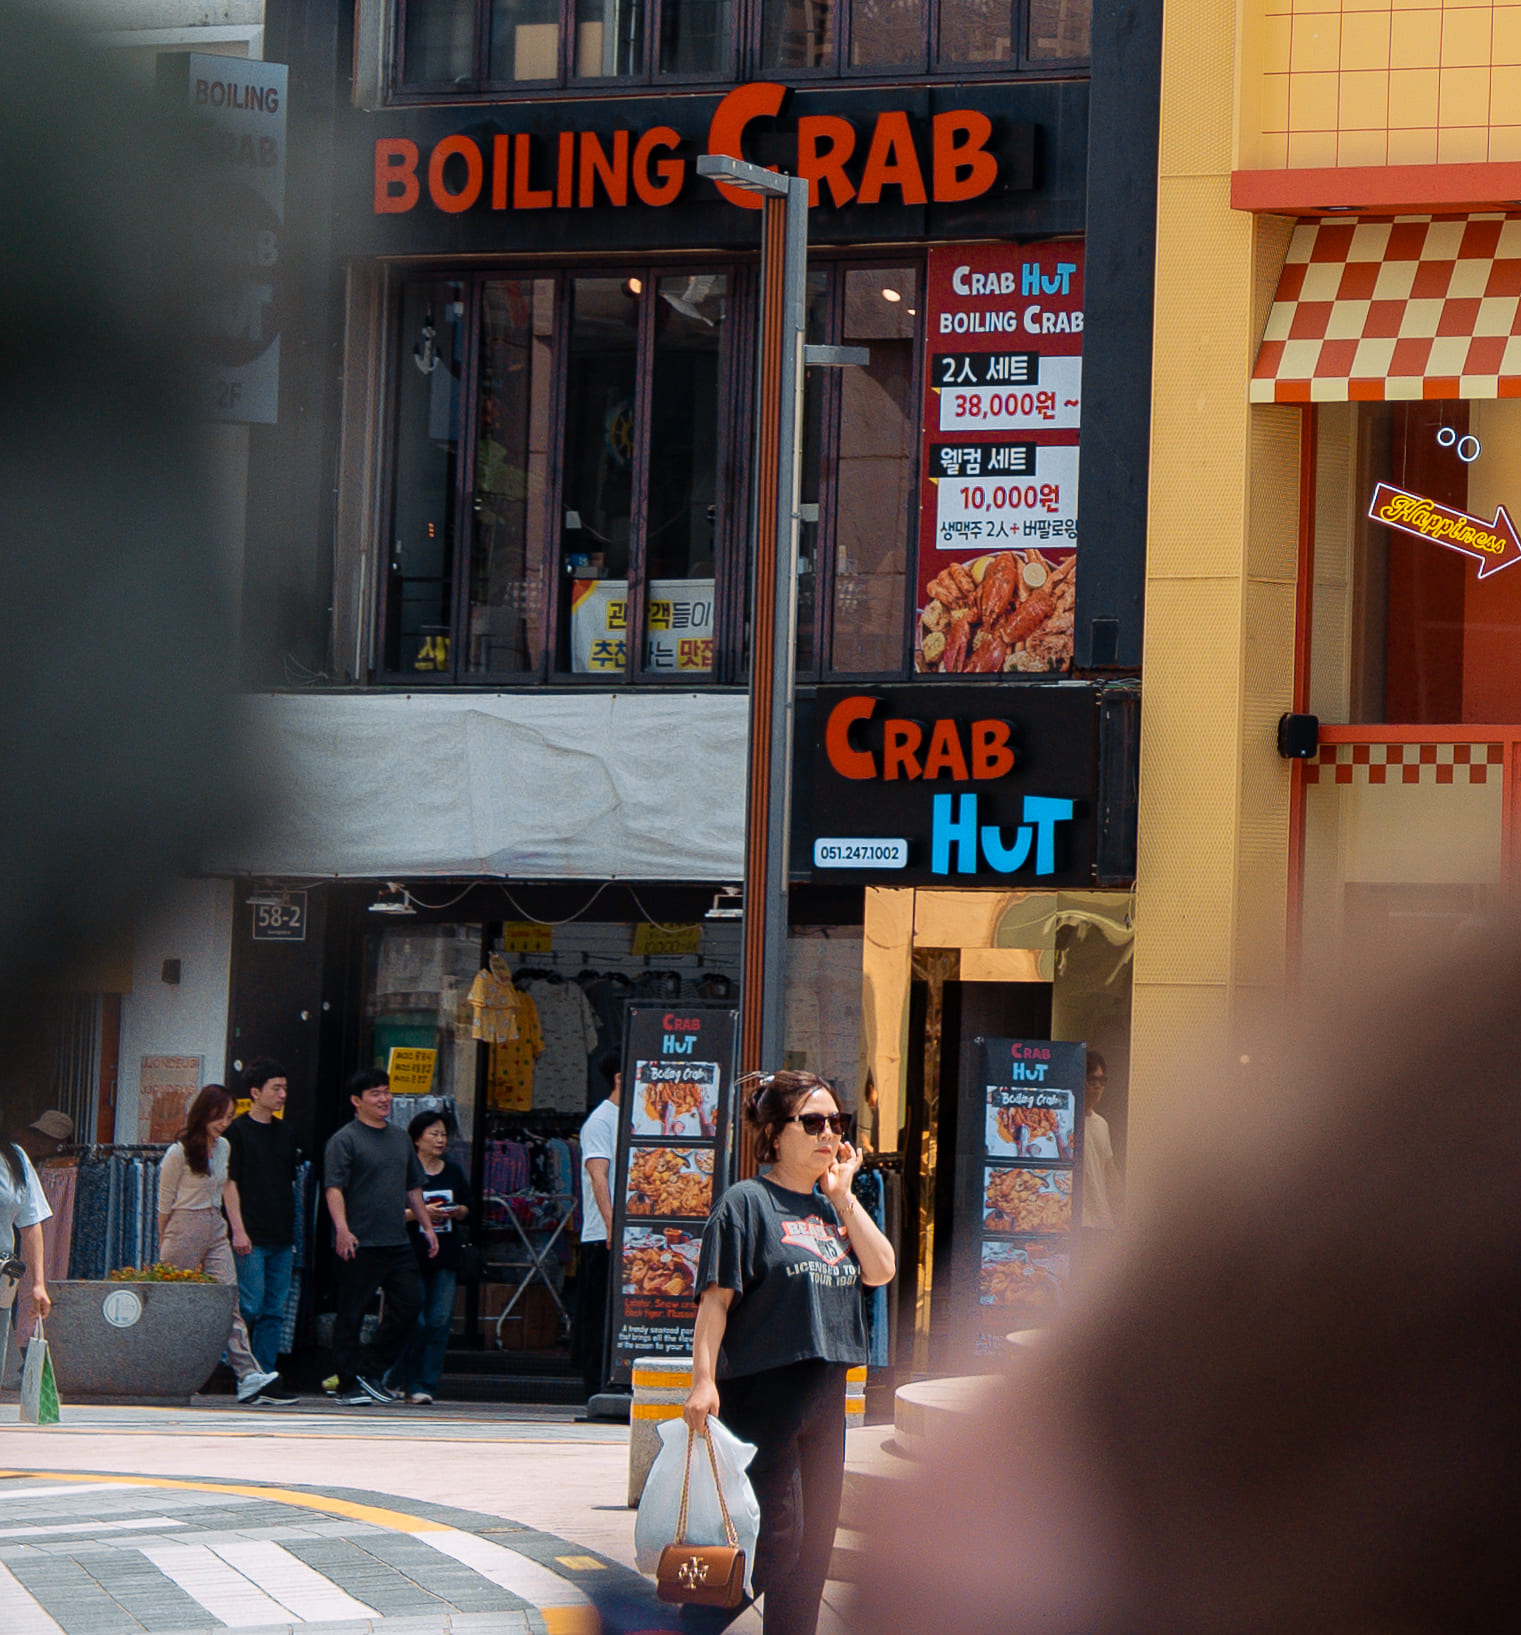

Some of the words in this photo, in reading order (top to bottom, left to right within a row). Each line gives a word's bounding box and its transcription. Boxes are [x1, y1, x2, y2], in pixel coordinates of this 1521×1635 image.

[195, 80, 279, 113] BOILING
[374, 126, 686, 214] BOILING
[939, 311, 1017, 333] BOILING
[986, 356, 1028, 381] 세트
[955, 391, 1056, 420] 38,000원
[940, 447, 981, 475] 웰컴
[987, 447, 1026, 470] 세트
[960, 484, 1059, 512] 10,000원
[940, 520, 982, 540] 생맥주
[1380, 495, 1506, 554] Happiness
[820, 846, 899, 860] 051.247.1002
[259, 906, 301, 927] 58-2
[809, 1271, 832, 1286] TOUR
